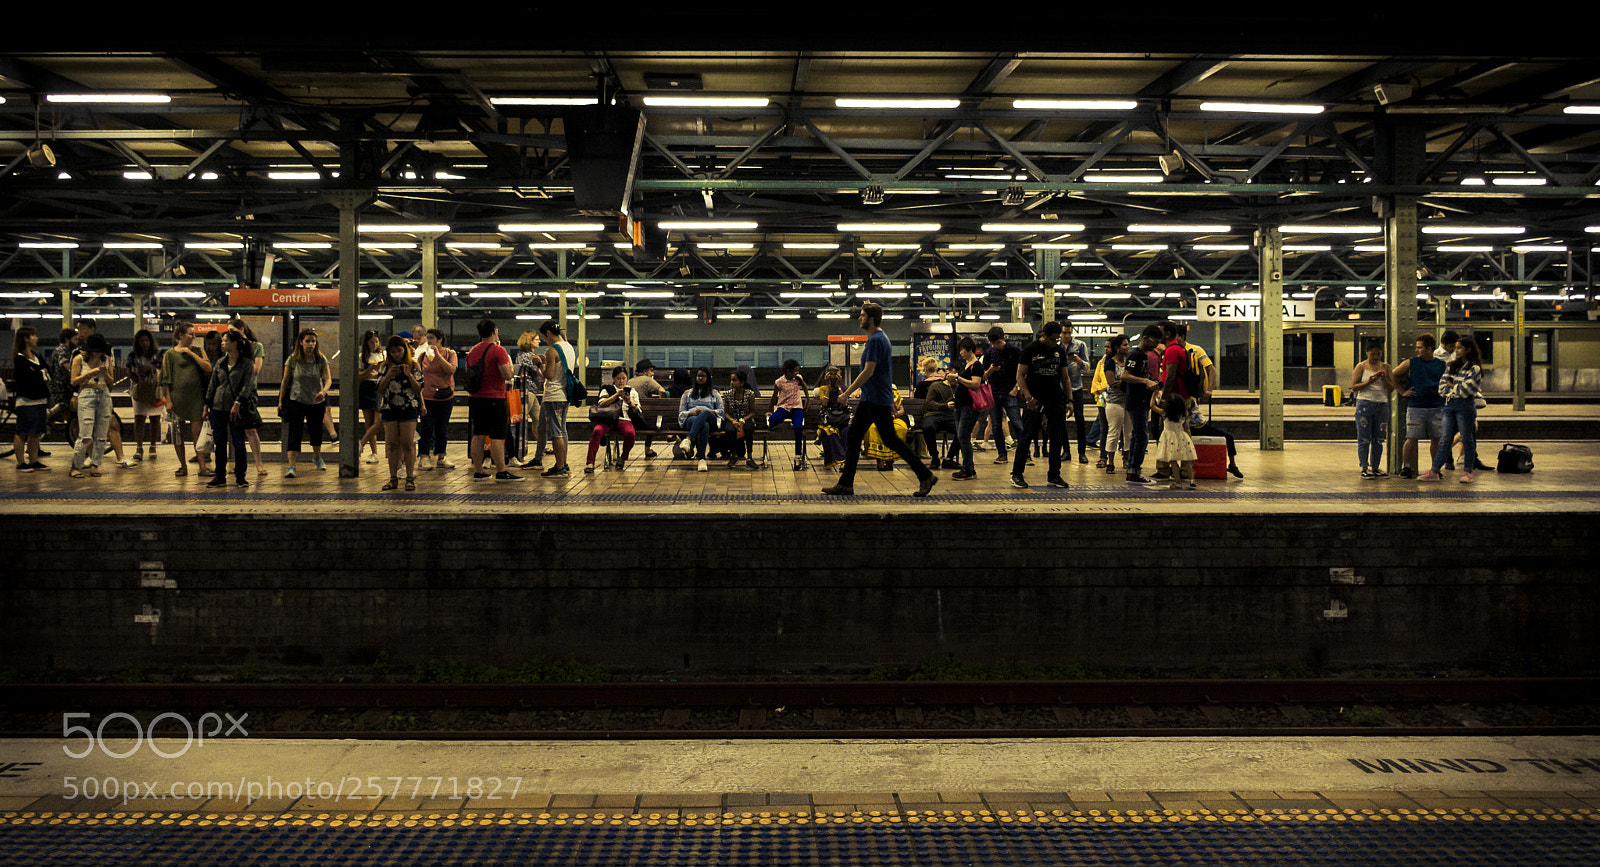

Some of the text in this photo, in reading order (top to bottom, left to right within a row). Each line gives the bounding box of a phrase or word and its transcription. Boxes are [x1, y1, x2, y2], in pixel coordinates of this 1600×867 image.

[271, 292, 311, 303] Central
[1206, 304, 1306, 317] CENTAL
[1126, 360, 1136, 368] 72
[1347, 758, 1508, 774] MIND
